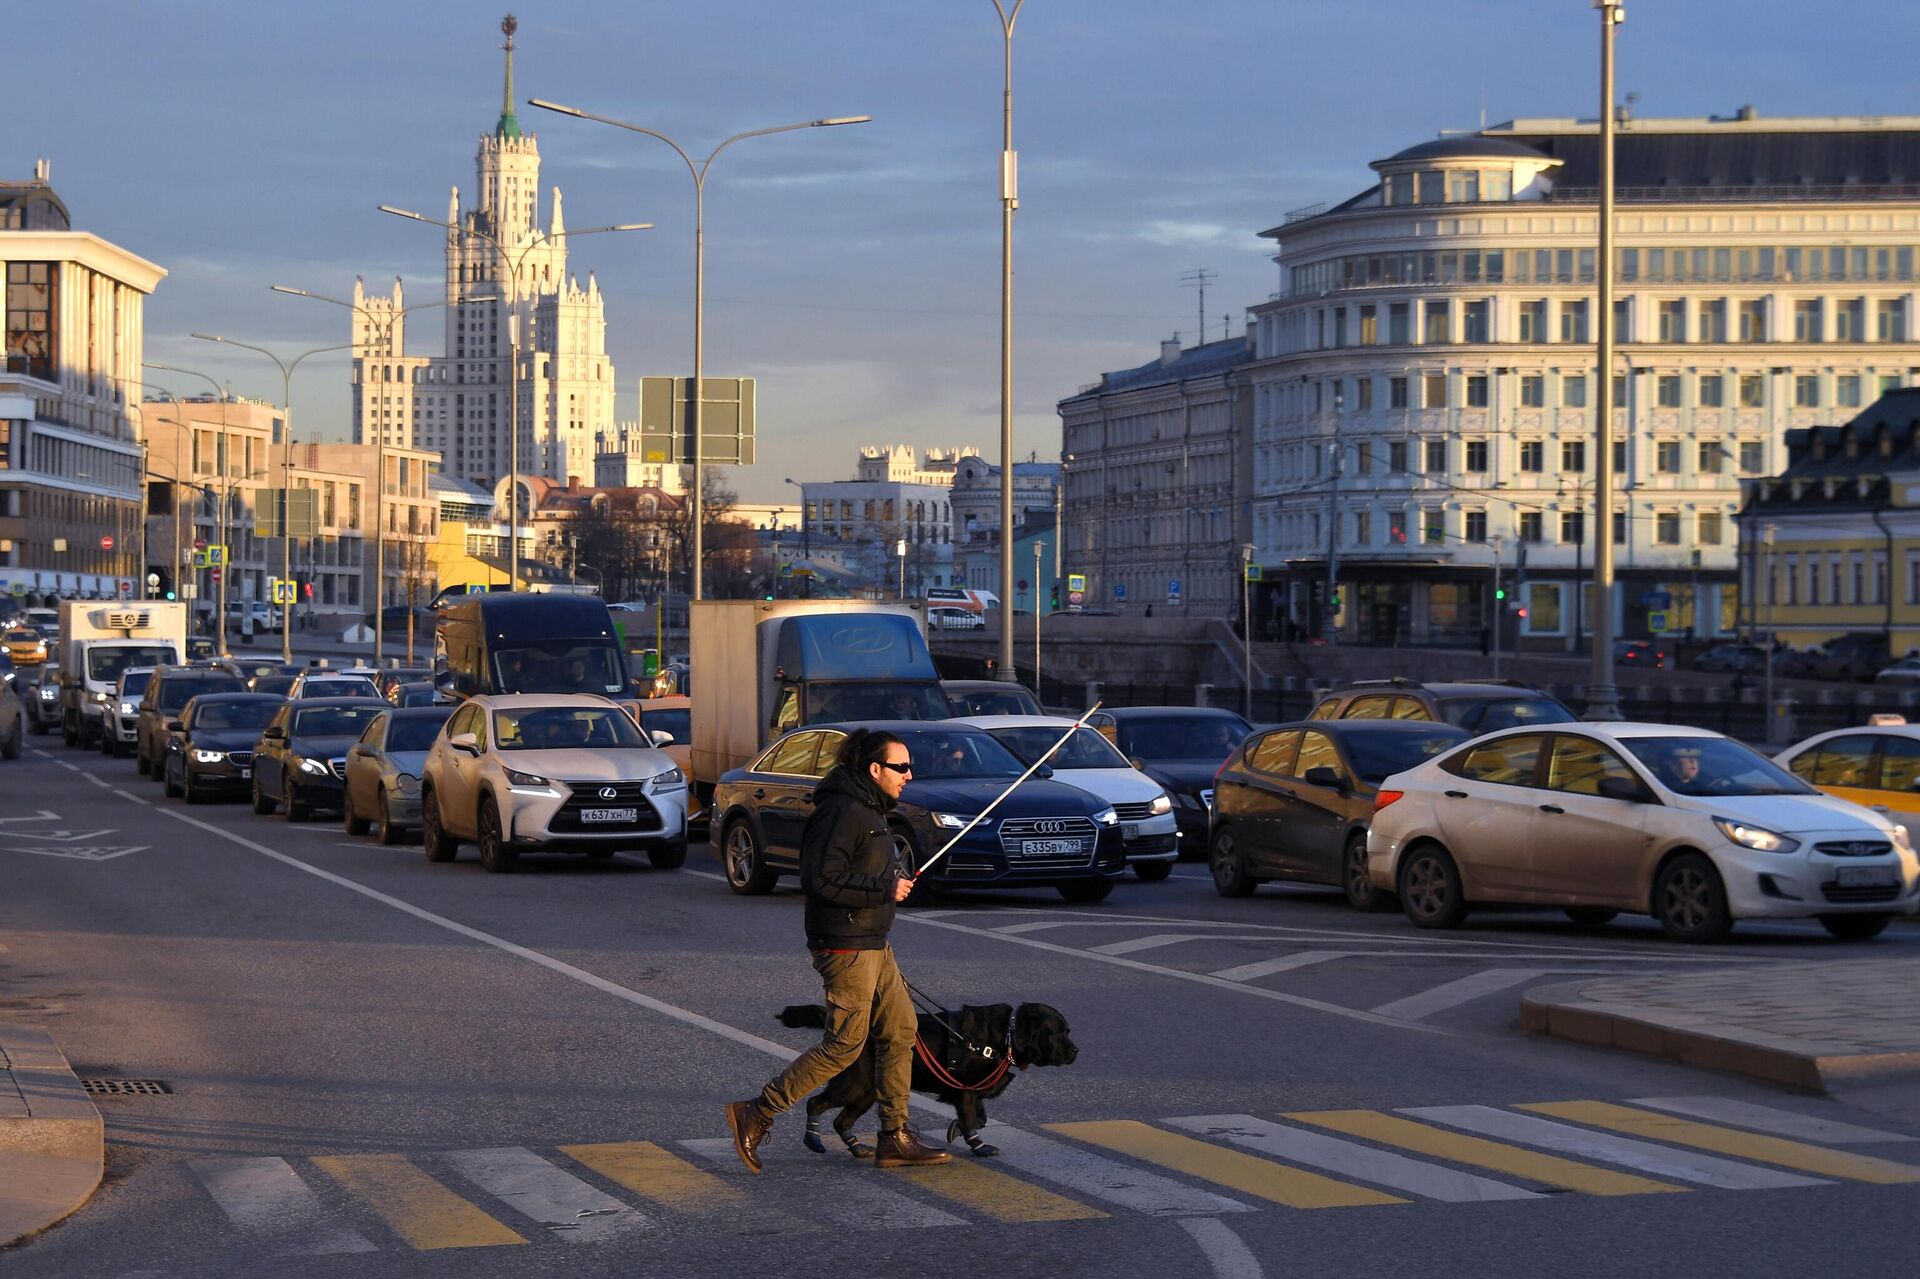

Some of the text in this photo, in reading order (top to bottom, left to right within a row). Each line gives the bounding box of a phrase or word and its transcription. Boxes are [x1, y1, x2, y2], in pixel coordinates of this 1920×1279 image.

[585, 809, 634, 820] К637ХН 77
[1025, 840, 1079, 853] Е335ВУ 799
